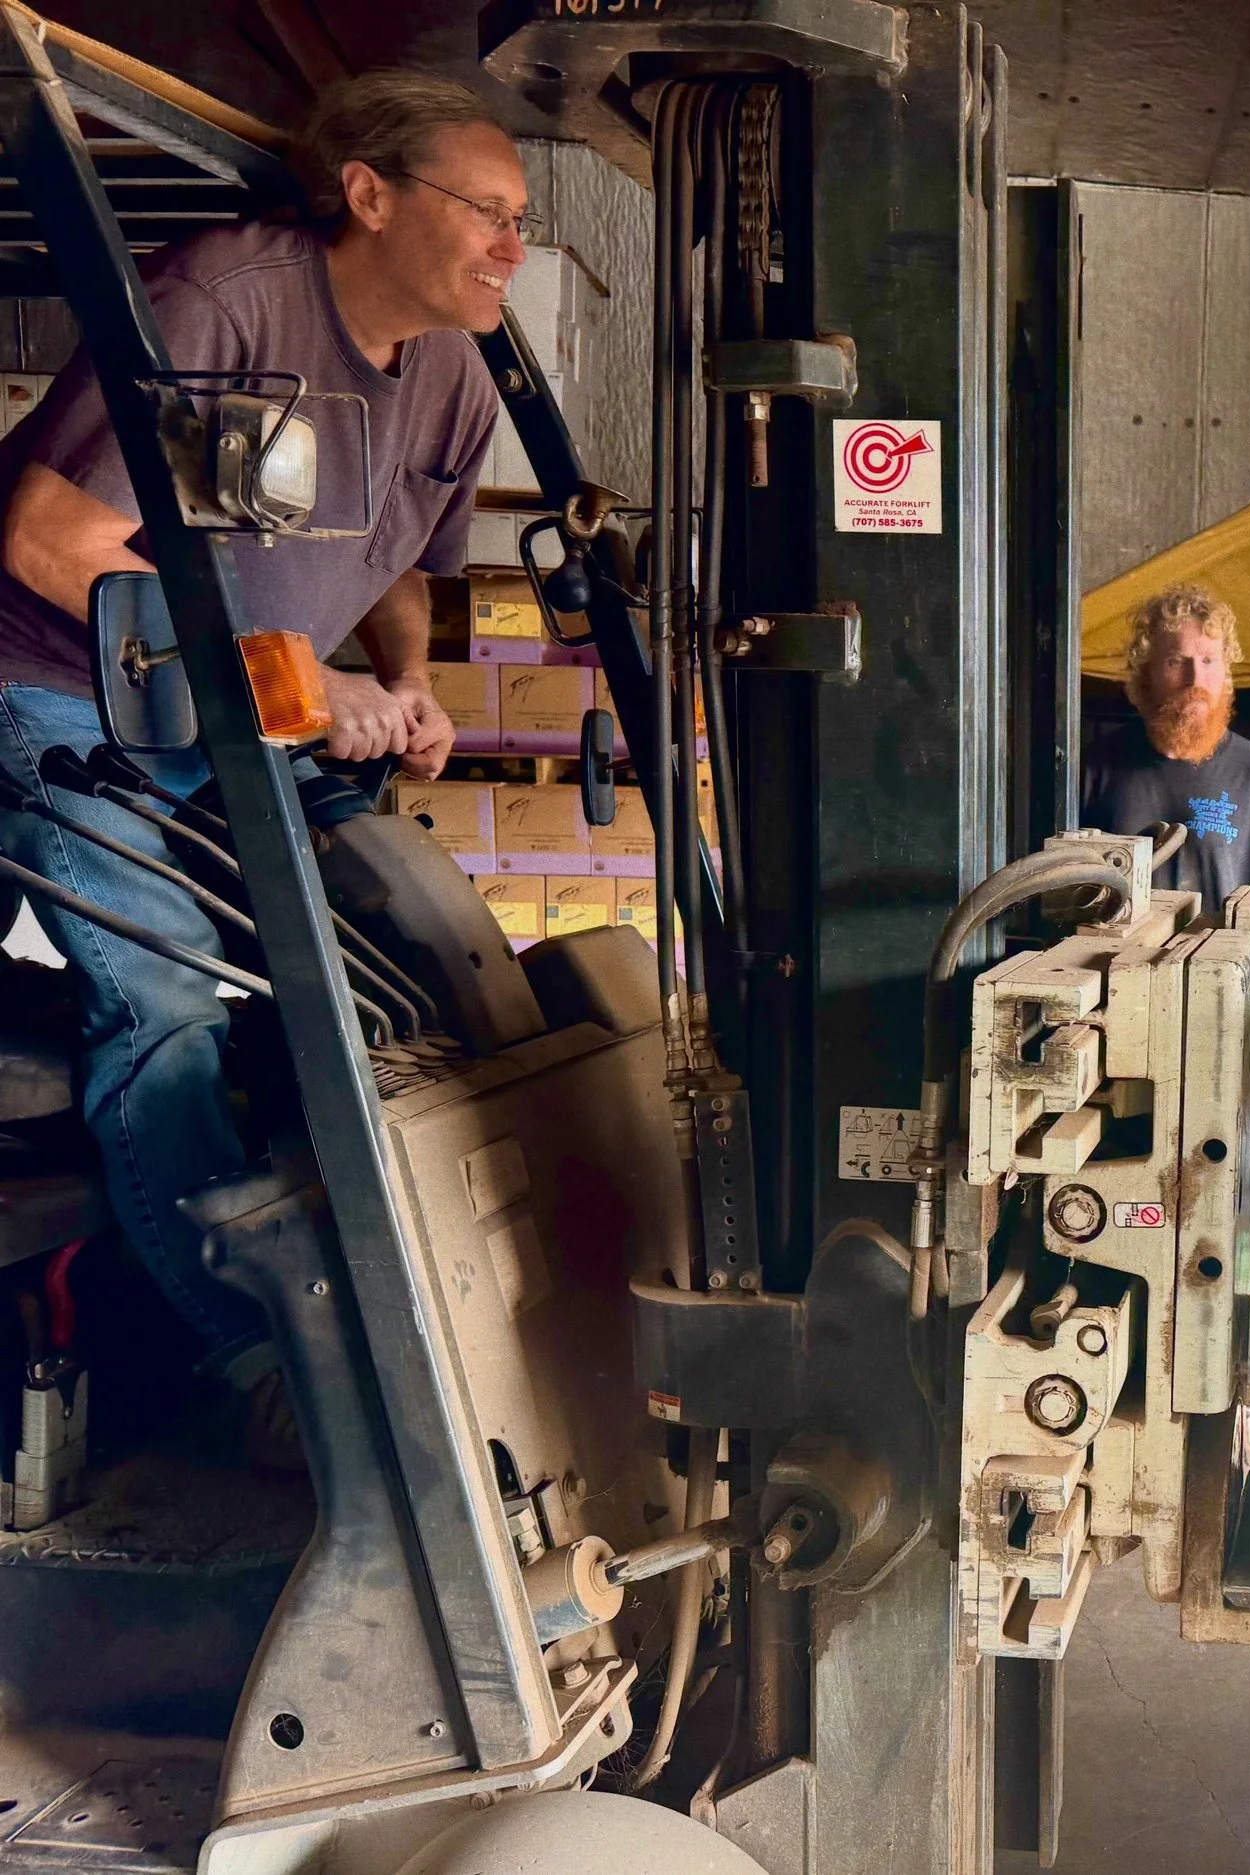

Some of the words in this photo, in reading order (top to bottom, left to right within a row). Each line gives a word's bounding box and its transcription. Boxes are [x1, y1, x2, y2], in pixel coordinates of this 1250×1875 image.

[844, 499, 889, 507] ACCURATE
[890, 500, 931, 508] FORKLIFT
[883, 508, 904, 516] Rosa,
[852, 518, 877, 527] (707)
[878, 518, 923, 528] 585-3675
[1185, 820, 1239, 838] CHAMPIONS
